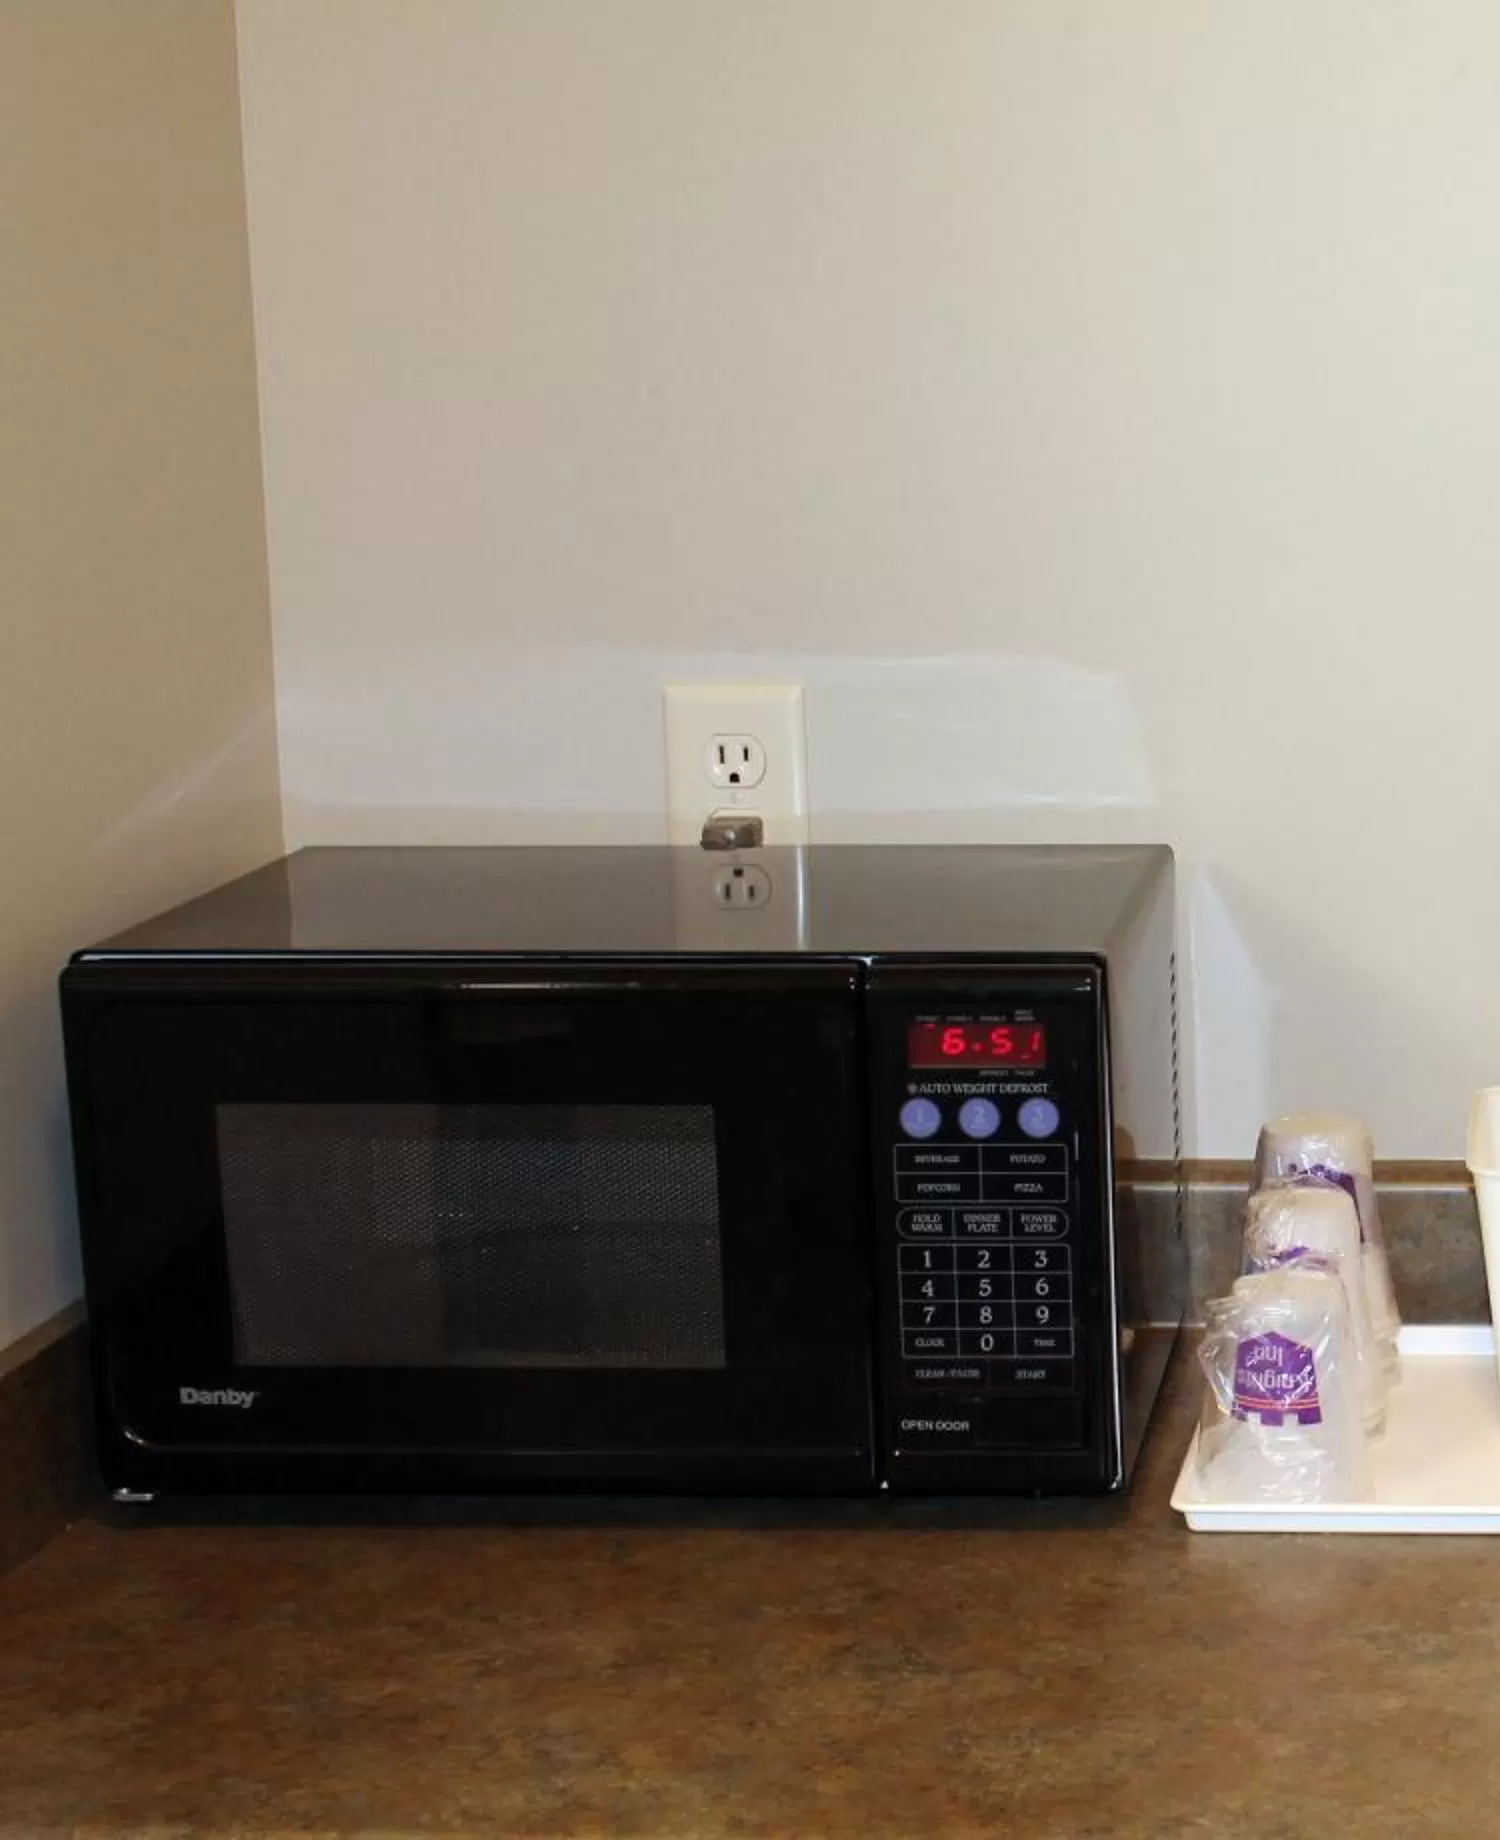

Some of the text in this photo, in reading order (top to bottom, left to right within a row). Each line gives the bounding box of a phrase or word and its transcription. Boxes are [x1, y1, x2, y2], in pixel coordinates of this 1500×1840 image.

[919, 1083, 1049, 1094] AUTO WEIGHT DEFROST
[922, 1250, 932, 1269] 1
[977, 1249, 992, 1269] 2
[1034, 1249, 1049, 1269] 3
[920, 1279, 935, 1298] 4
[978, 1278, 992, 1297] 5
[1035, 1277, 1049, 1296] 6
[922, 1305, 936, 1324] 7
[979, 1305, 993, 1324] 8
[1035, 1305, 1050, 1324] 9
[979, 1333, 994, 1352] 0
[179, 1386, 255, 1409] Danby
[901, 1420, 970, 1432] OPEN DOOR
